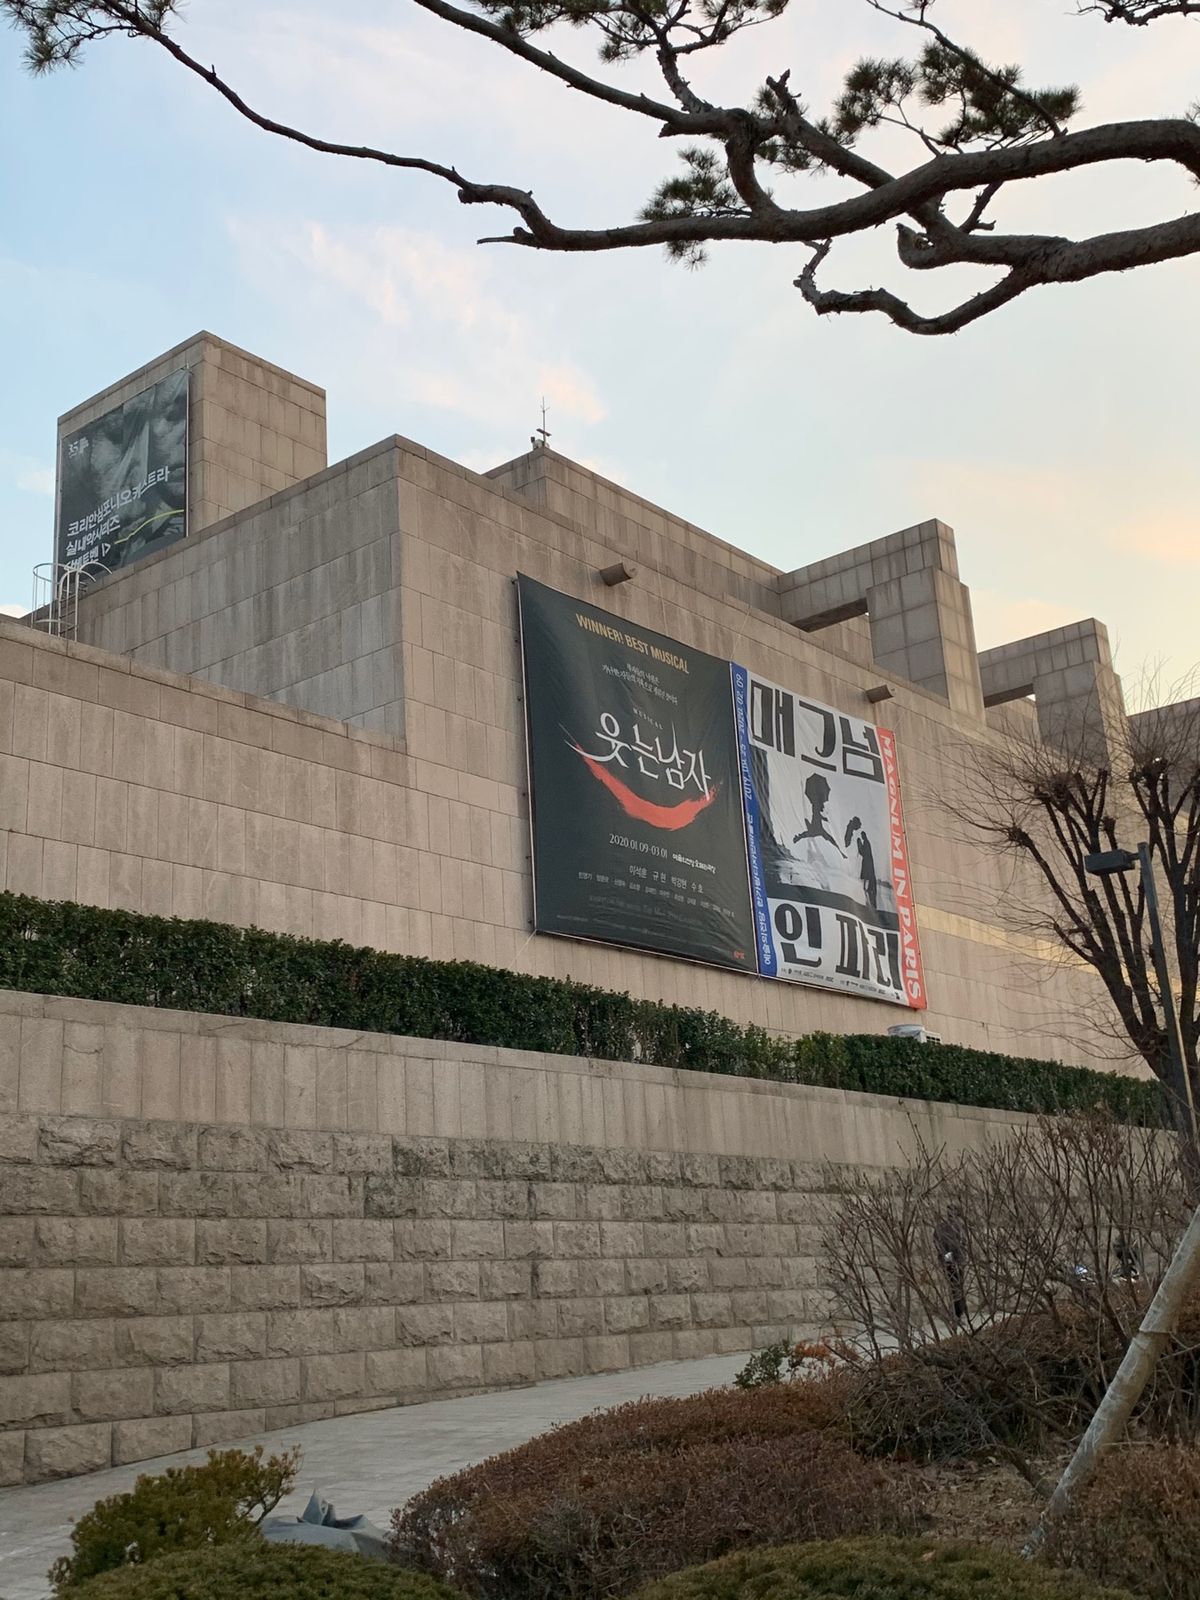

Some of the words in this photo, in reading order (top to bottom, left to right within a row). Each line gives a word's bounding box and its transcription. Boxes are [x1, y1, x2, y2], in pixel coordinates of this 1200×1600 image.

[66, 515, 121, 557] 실내악시리즈
[67, 465, 171, 537] 코리안심포니오케스트라
[576, 613, 624, 645] WINNER!
[625, 635, 649, 656] BEST
[650, 645, 690, 675] MUSICAL
[751, 679, 885, 785] 매그넘
[880, 734, 903, 860] MAGNUM
[893, 870, 908, 899] IN
[774, 903, 822, 968] 인
[835, 913, 903, 991] 파리
[900, 906, 922, 1000] PARIS
